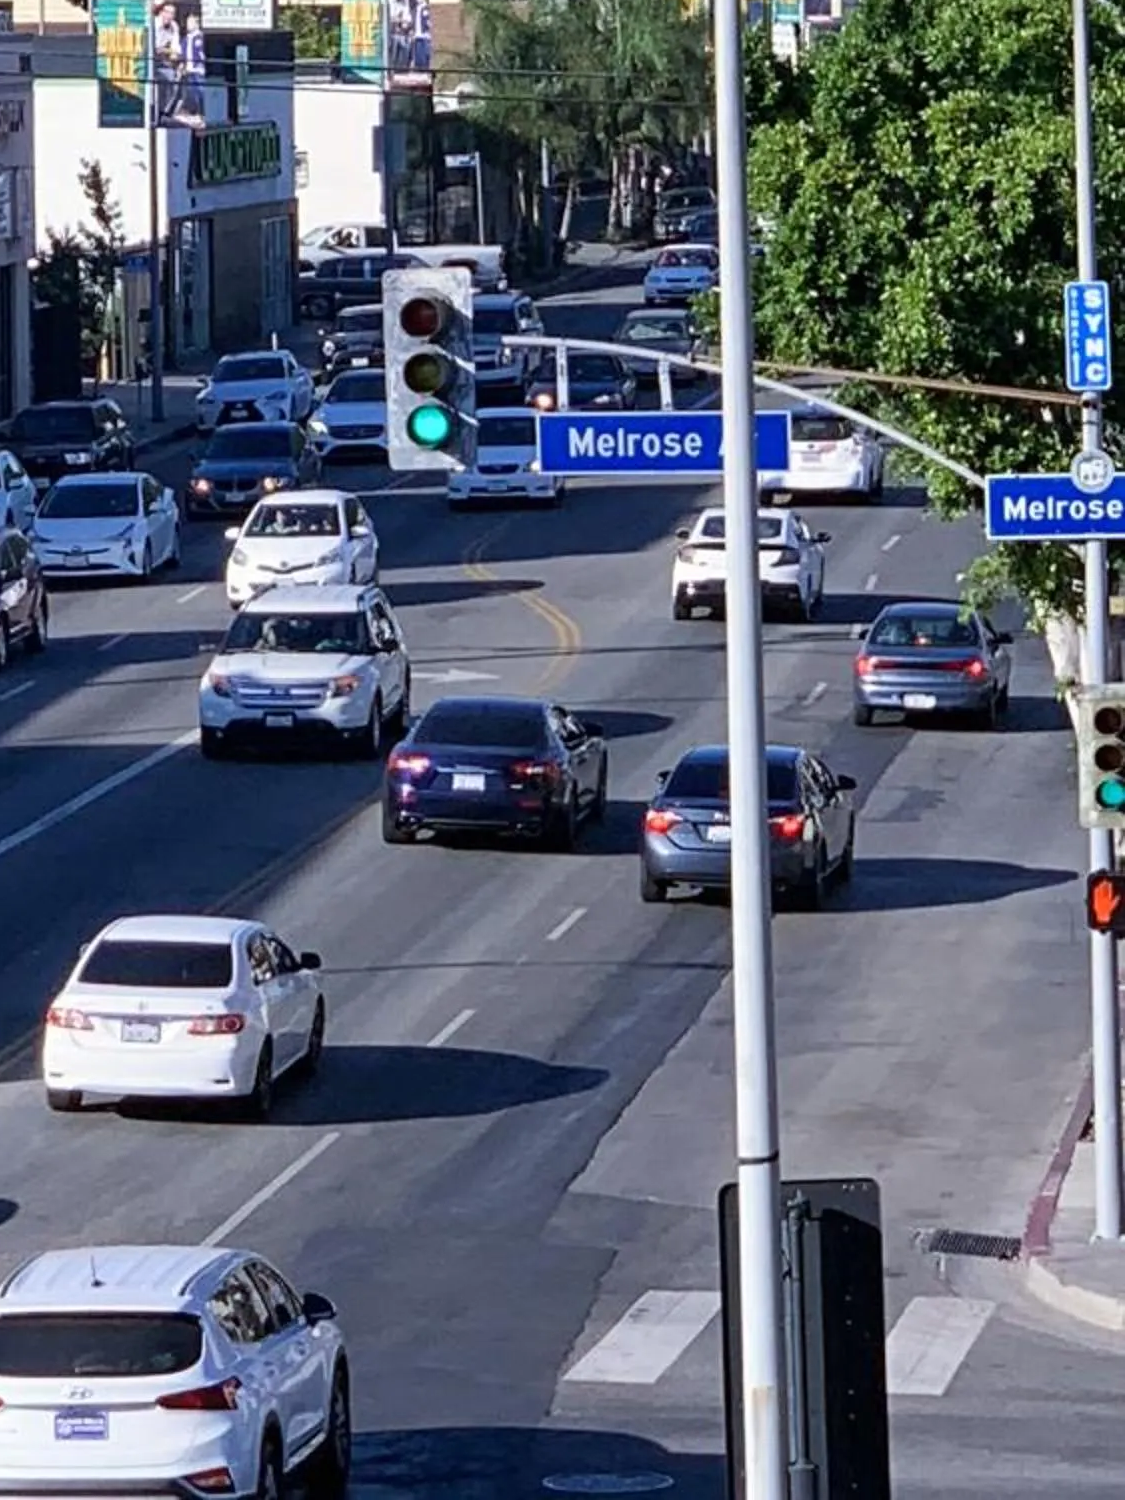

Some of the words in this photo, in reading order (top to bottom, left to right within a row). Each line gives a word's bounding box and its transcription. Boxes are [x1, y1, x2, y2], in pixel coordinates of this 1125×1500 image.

[1083, 288, 1105, 382] SYNC
[568, 427, 702, 458] Melrose
[1003, 496, 1124, 521] Melrose
